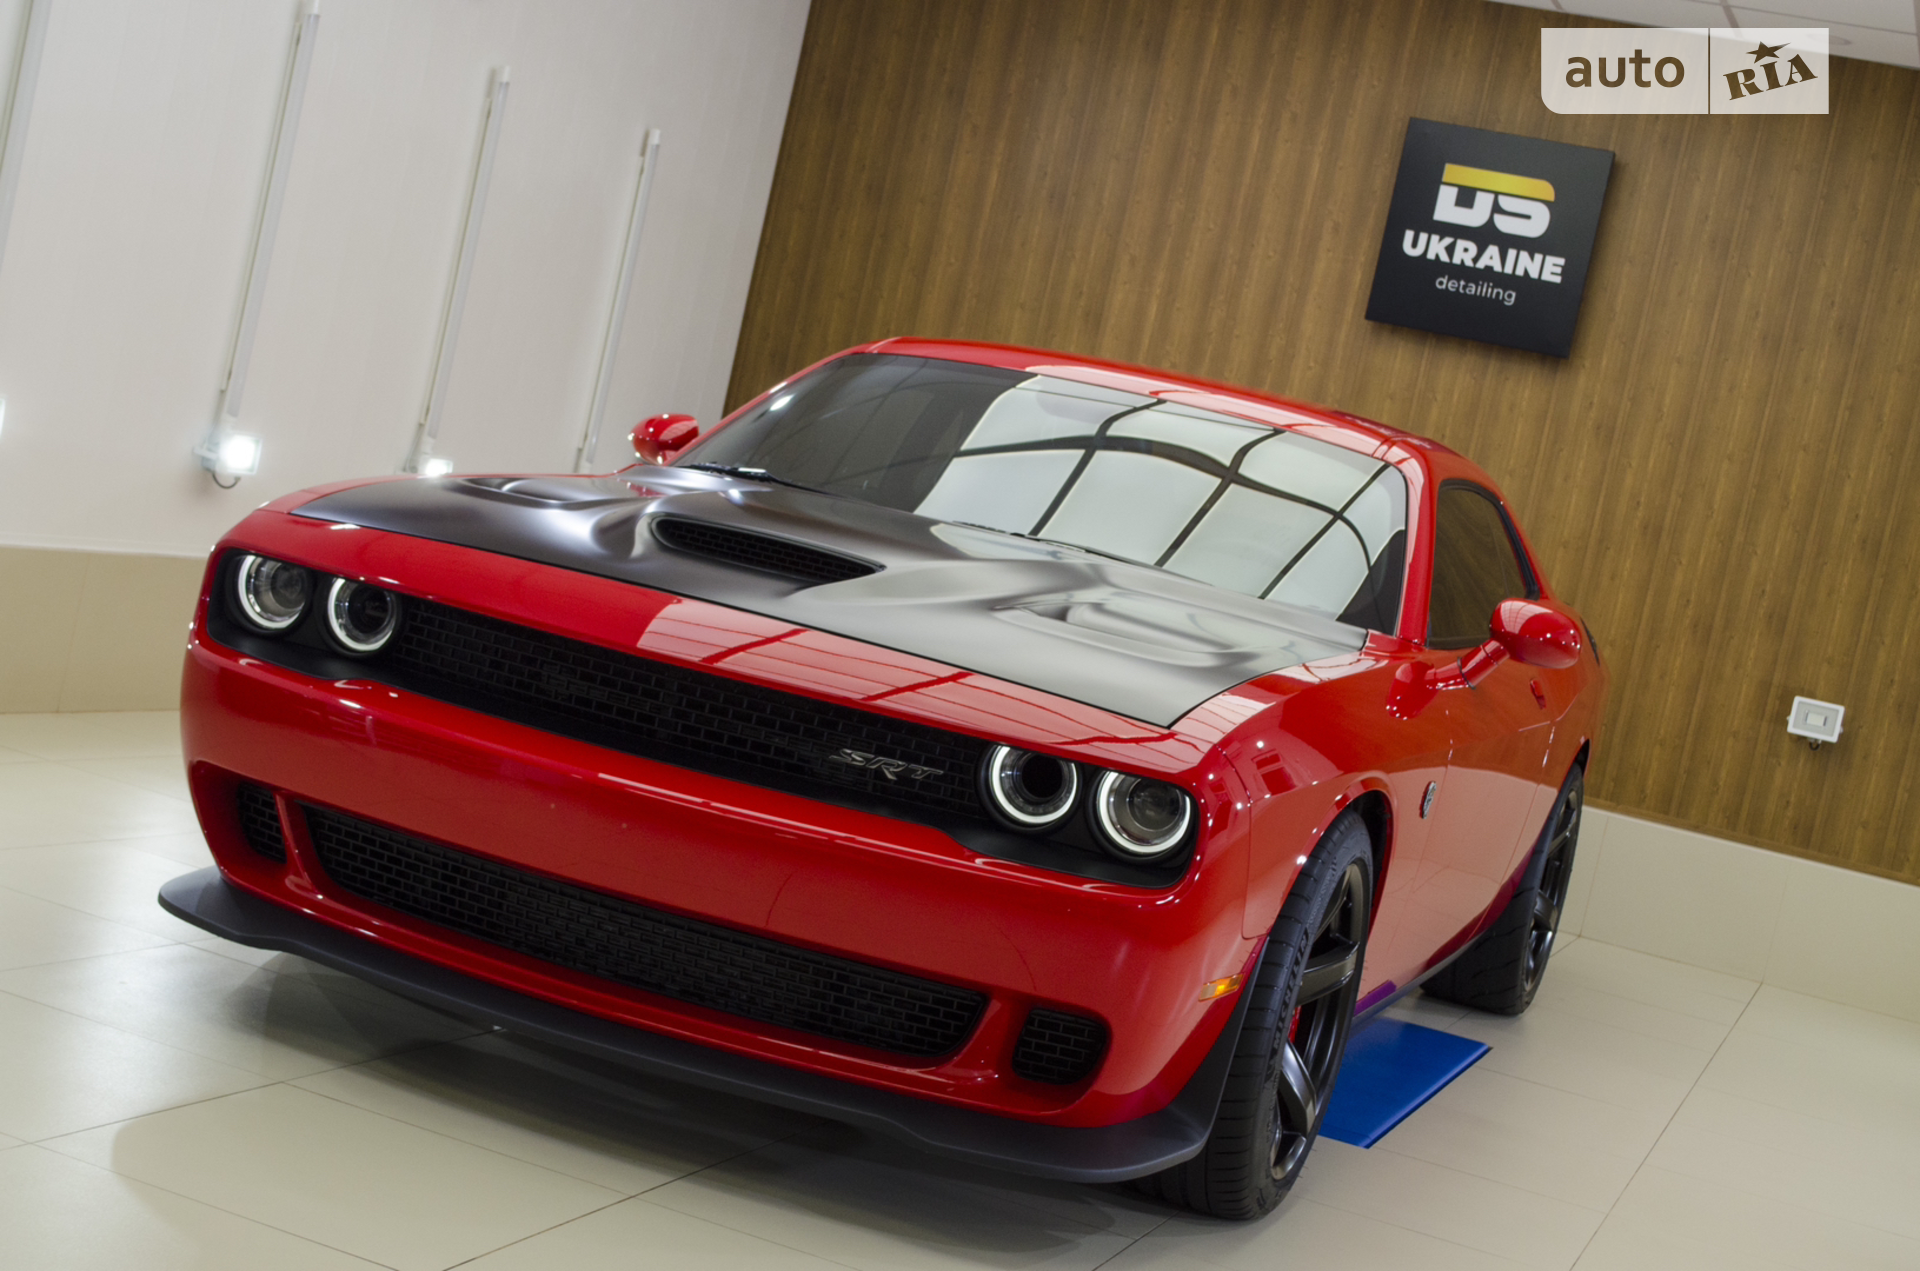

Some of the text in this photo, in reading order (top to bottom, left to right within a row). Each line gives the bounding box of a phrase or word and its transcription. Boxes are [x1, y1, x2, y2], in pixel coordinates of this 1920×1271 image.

[1402, 229, 1566, 284] UKRAINE
[1435, 275, 1517, 306] detailing
[829, 748, 944, 780] SRT
